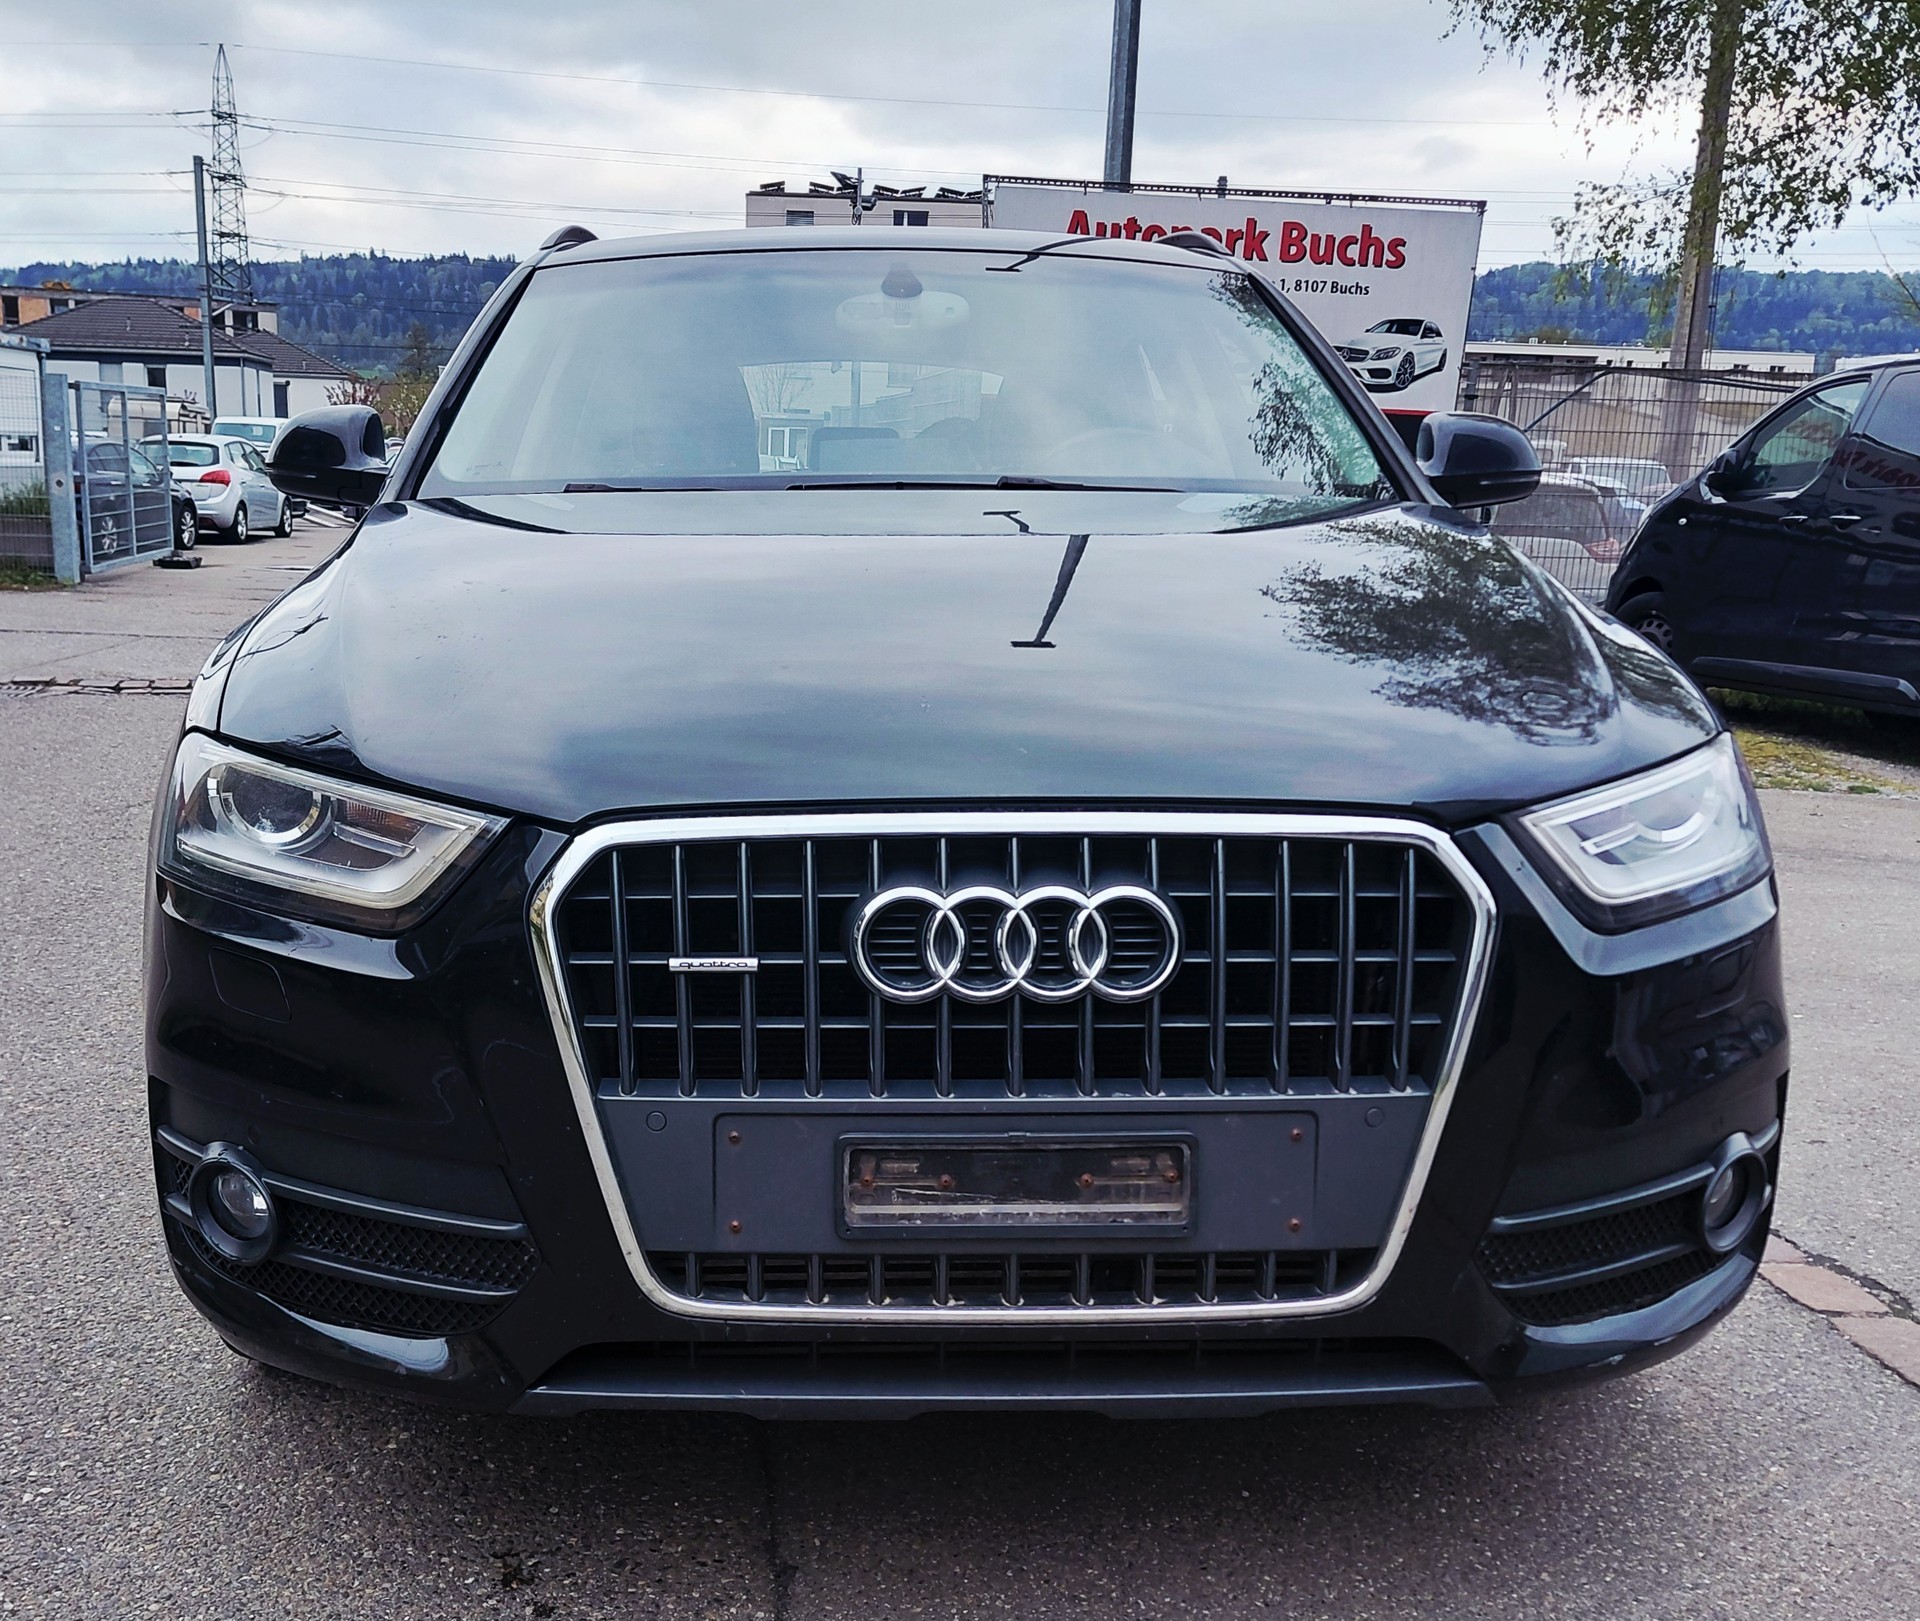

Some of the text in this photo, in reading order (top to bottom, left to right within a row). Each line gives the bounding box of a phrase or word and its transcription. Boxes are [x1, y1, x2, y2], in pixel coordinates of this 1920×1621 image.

[1279, 221, 1407, 269] Buchs
[1279, 278, 1370, 296] 1, 8107 Buchs
[677, 959, 750, 970] quattro
